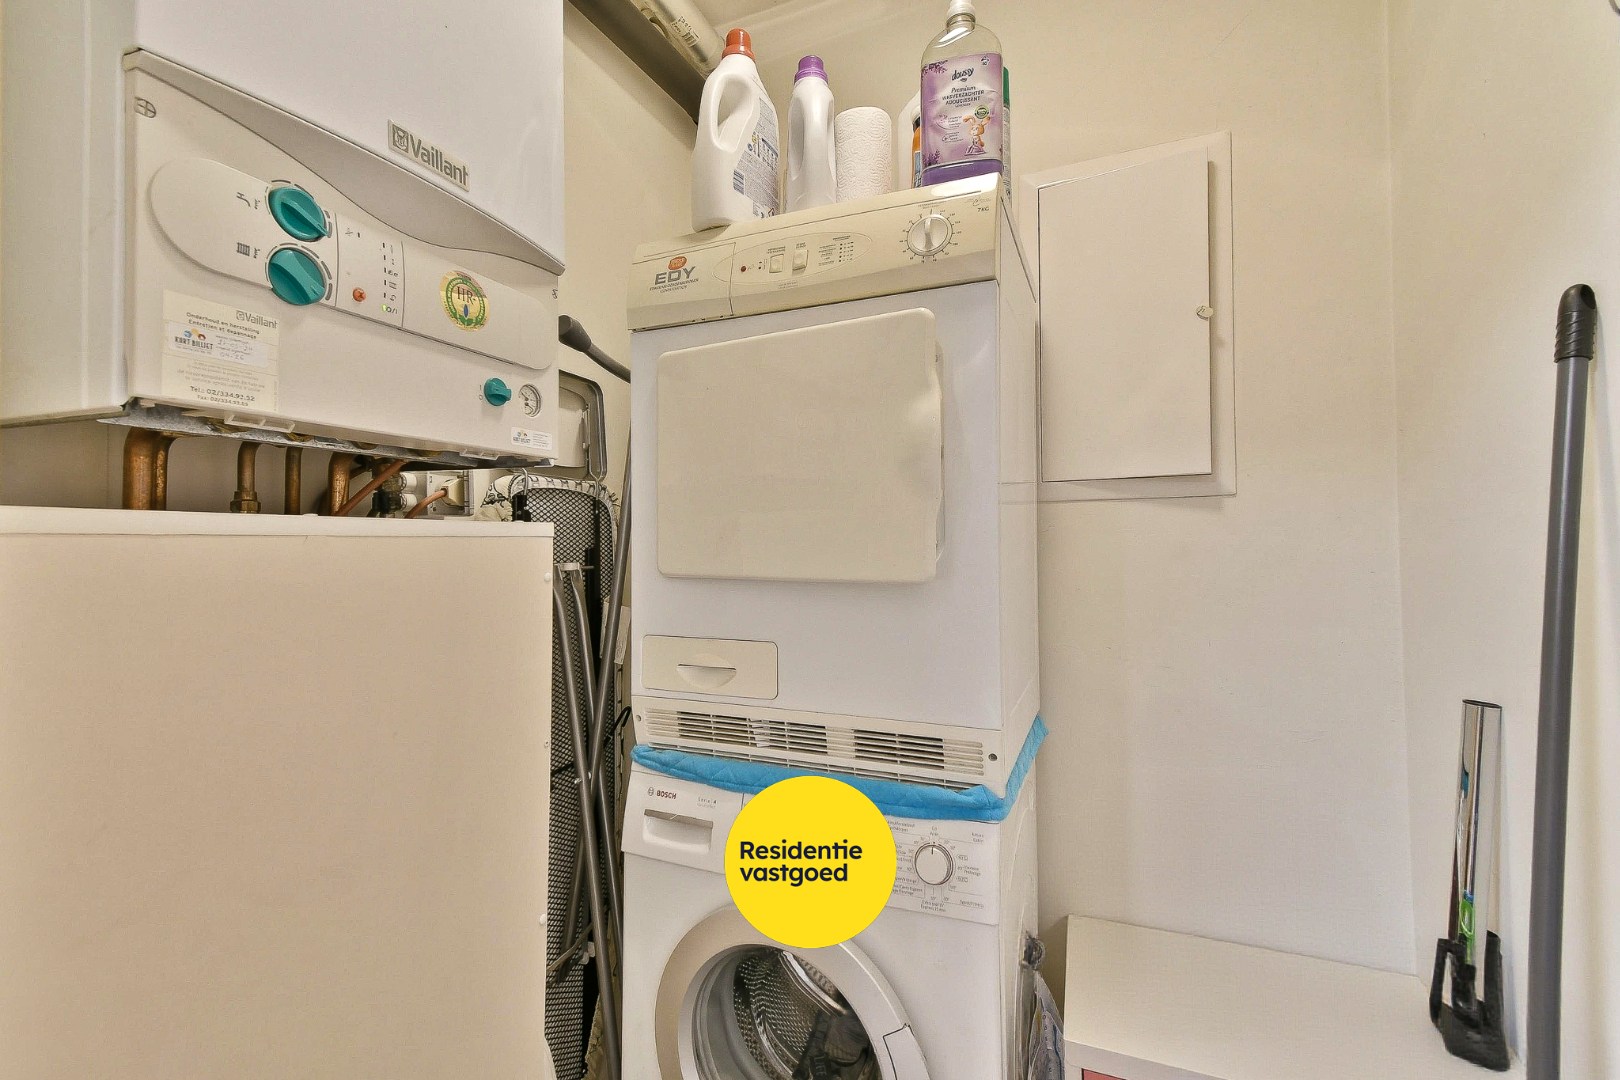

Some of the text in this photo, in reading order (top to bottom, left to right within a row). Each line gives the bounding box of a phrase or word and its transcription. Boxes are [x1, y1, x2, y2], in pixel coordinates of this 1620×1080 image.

[409, 133, 469, 186] Vaillant
[654, 266, 696, 285] EDY
[244, 312, 278, 329] Vaillant
[656, 790, 677, 800] BOSCH
